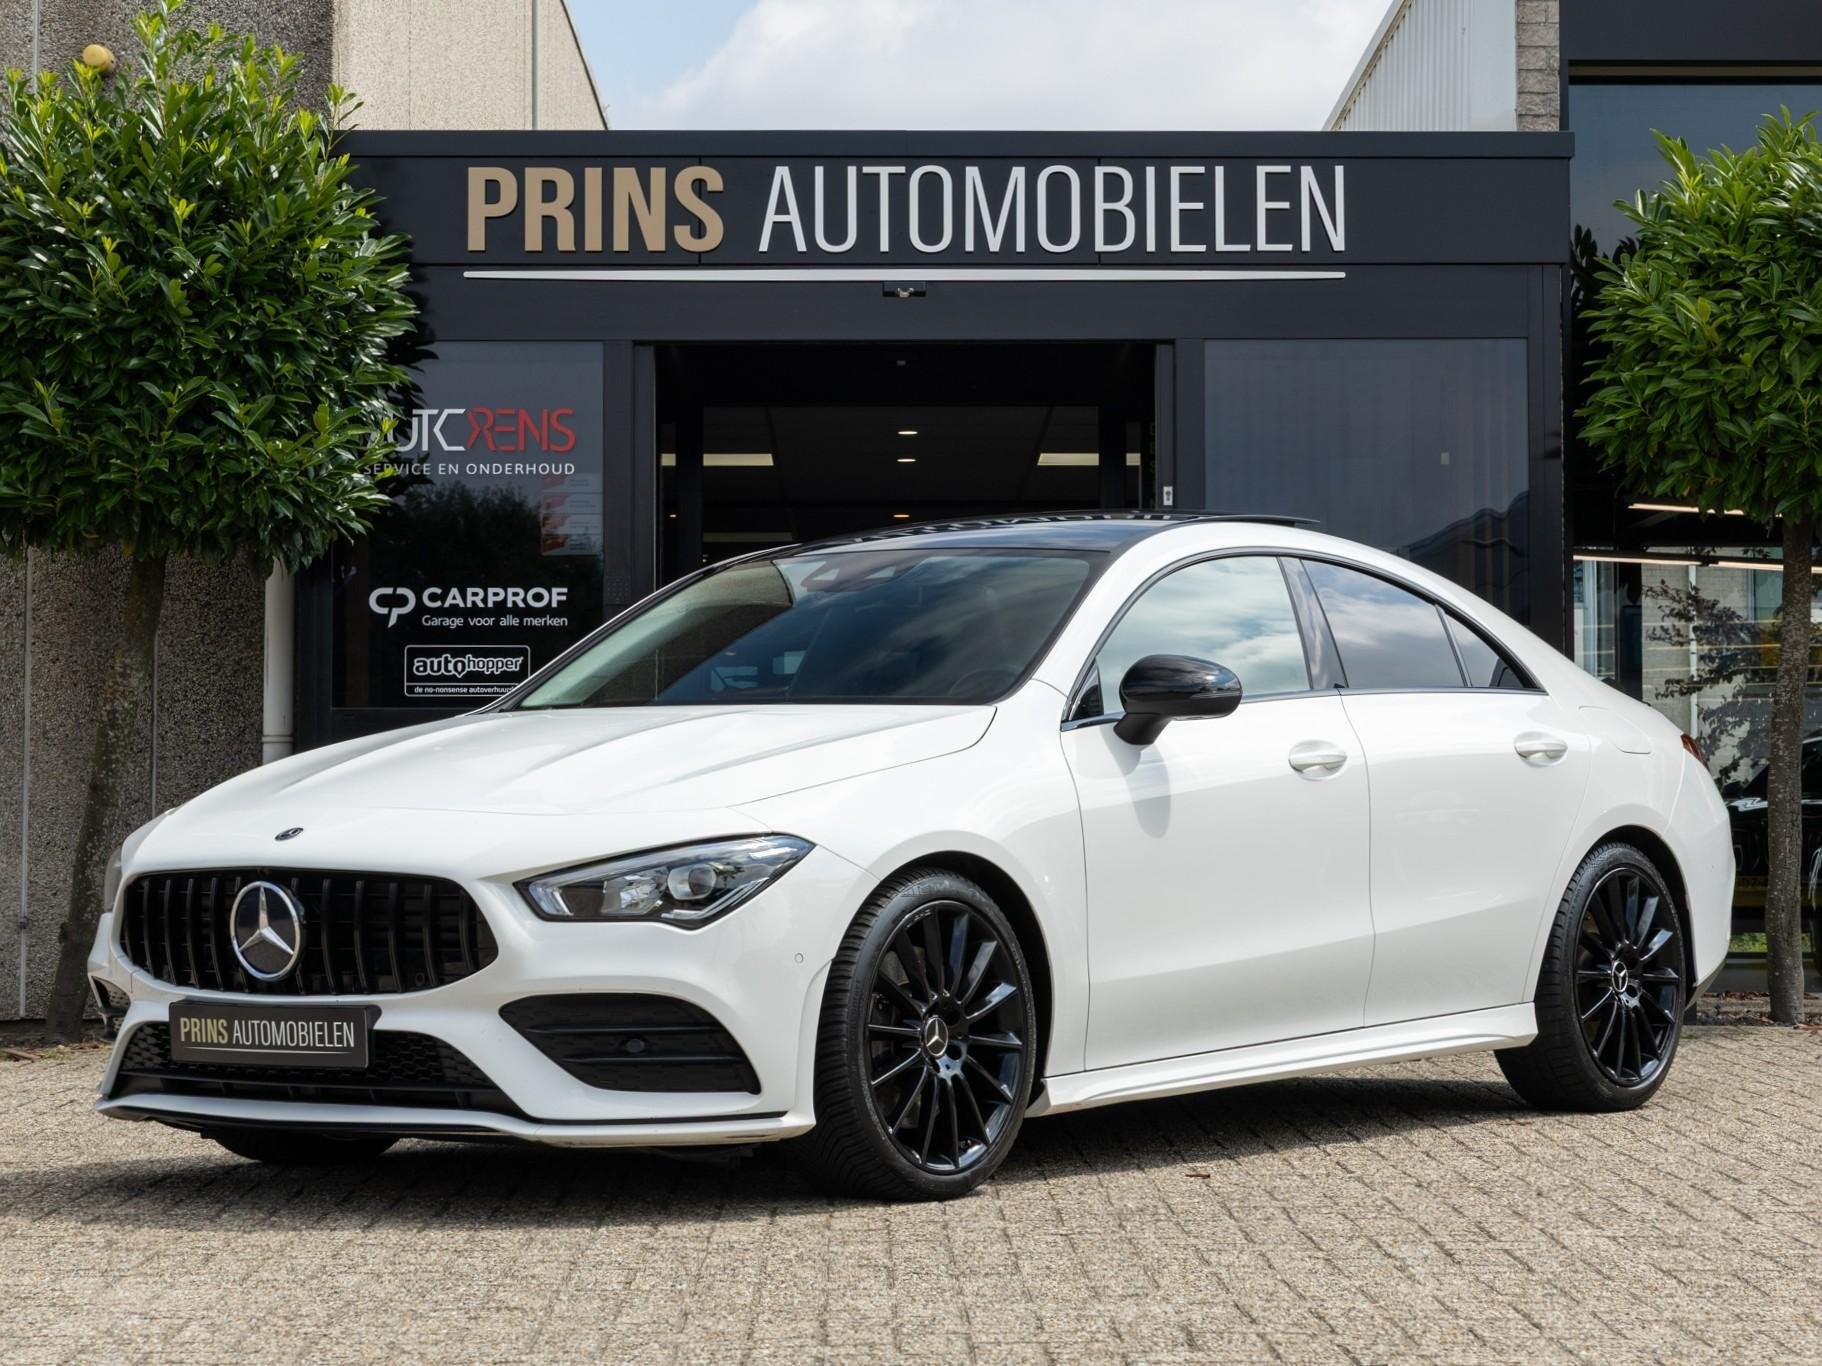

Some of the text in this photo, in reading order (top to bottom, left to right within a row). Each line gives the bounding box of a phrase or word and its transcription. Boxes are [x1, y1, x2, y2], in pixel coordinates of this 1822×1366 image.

[466, 164, 1346, 253] PRINS AUTOMOBIELEN
[438, 463, 459, 475] EN
[465, 463, 576, 475] ONDERHOUD
[422, 586, 568, 608] CARPROF
[421, 614, 568, 628] Garage voor alle merken
[413, 653, 524, 678] autohopper
[414, 685, 424, 693] de
[179, 1016, 355, 1048] PRINS AUTOMOBIELEN
